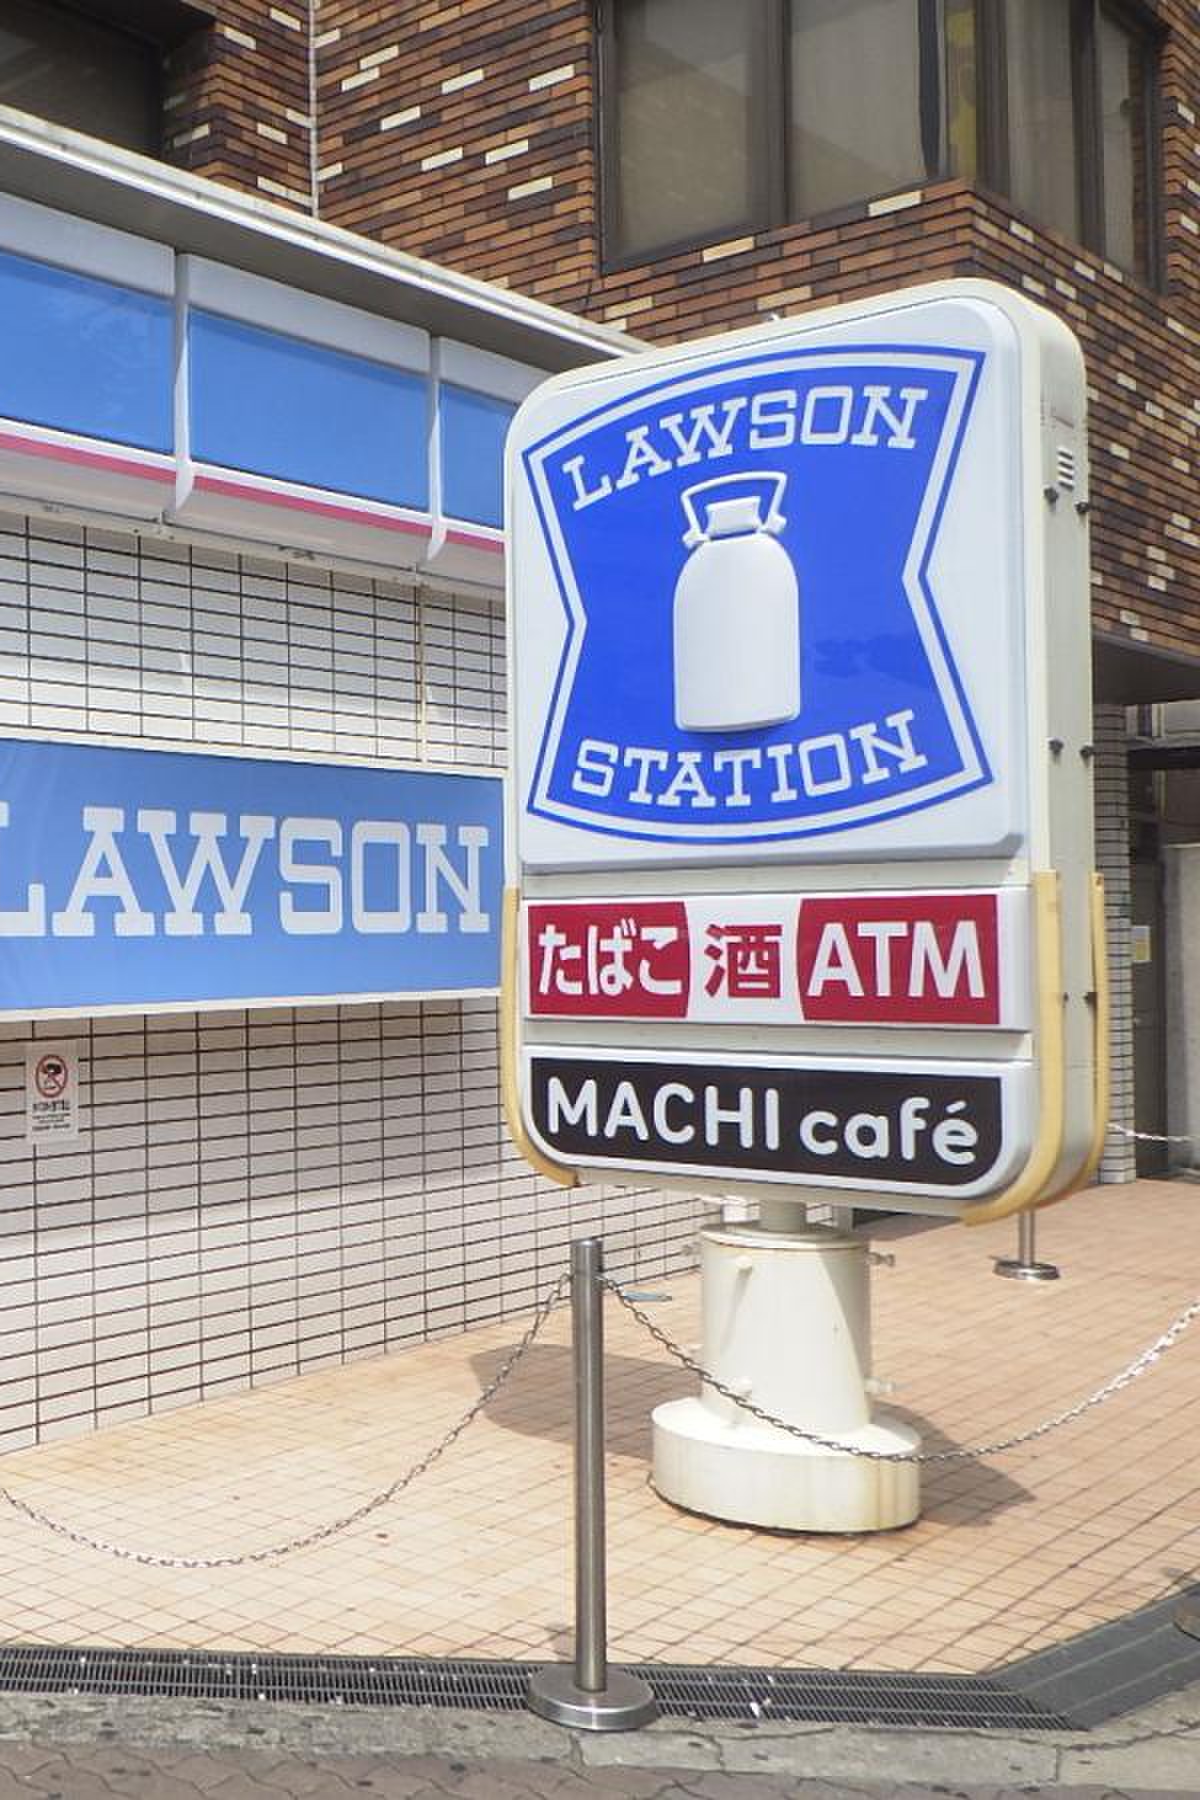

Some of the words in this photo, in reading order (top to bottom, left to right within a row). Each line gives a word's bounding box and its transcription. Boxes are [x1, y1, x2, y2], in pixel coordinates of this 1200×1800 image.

[562, 385, 927, 511] LAWSON
[571, 709, 927, 808] STATION
[538, 917, 682, 997] たばこ
[704, 923, 784, 999] 酒
[807, 920, 986, 999] ATM
[546, 1076, 780, 1151] MACHI
[799, 1097, 978, 1166] café
